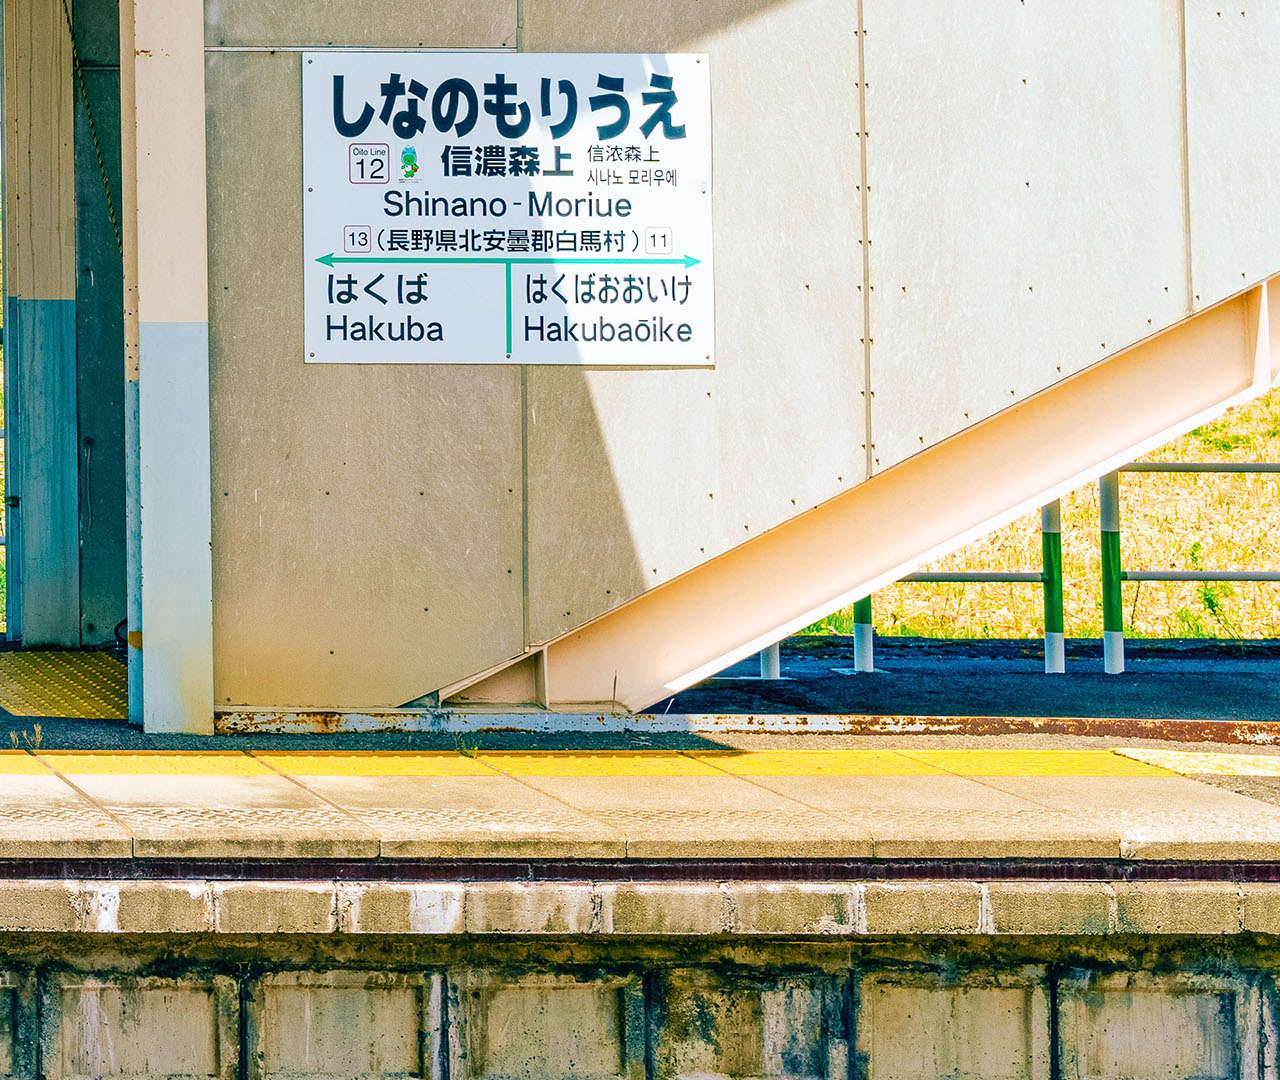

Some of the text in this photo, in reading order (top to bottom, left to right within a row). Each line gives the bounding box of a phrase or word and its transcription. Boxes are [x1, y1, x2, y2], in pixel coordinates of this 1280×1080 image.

[332, 73, 687, 140] しなのもりうえ
[370, 148, 386, 156] Line
[440, 145, 574, 177] 信濃森上
[587, 145, 660, 163] 信浓森上
[356, 158, 384, 179] 12
[587, 168, 677, 187] 시나노 모리우에
[348, 231, 368, 247] 13
[650, 233, 667, 247] 11
[327, 272, 429, 305] はくば
[525, 273, 692, 306] はくばおおいけ
[326, 315, 444, 342] Hakuba
[524, 316, 692, 343] Hakubaōike
